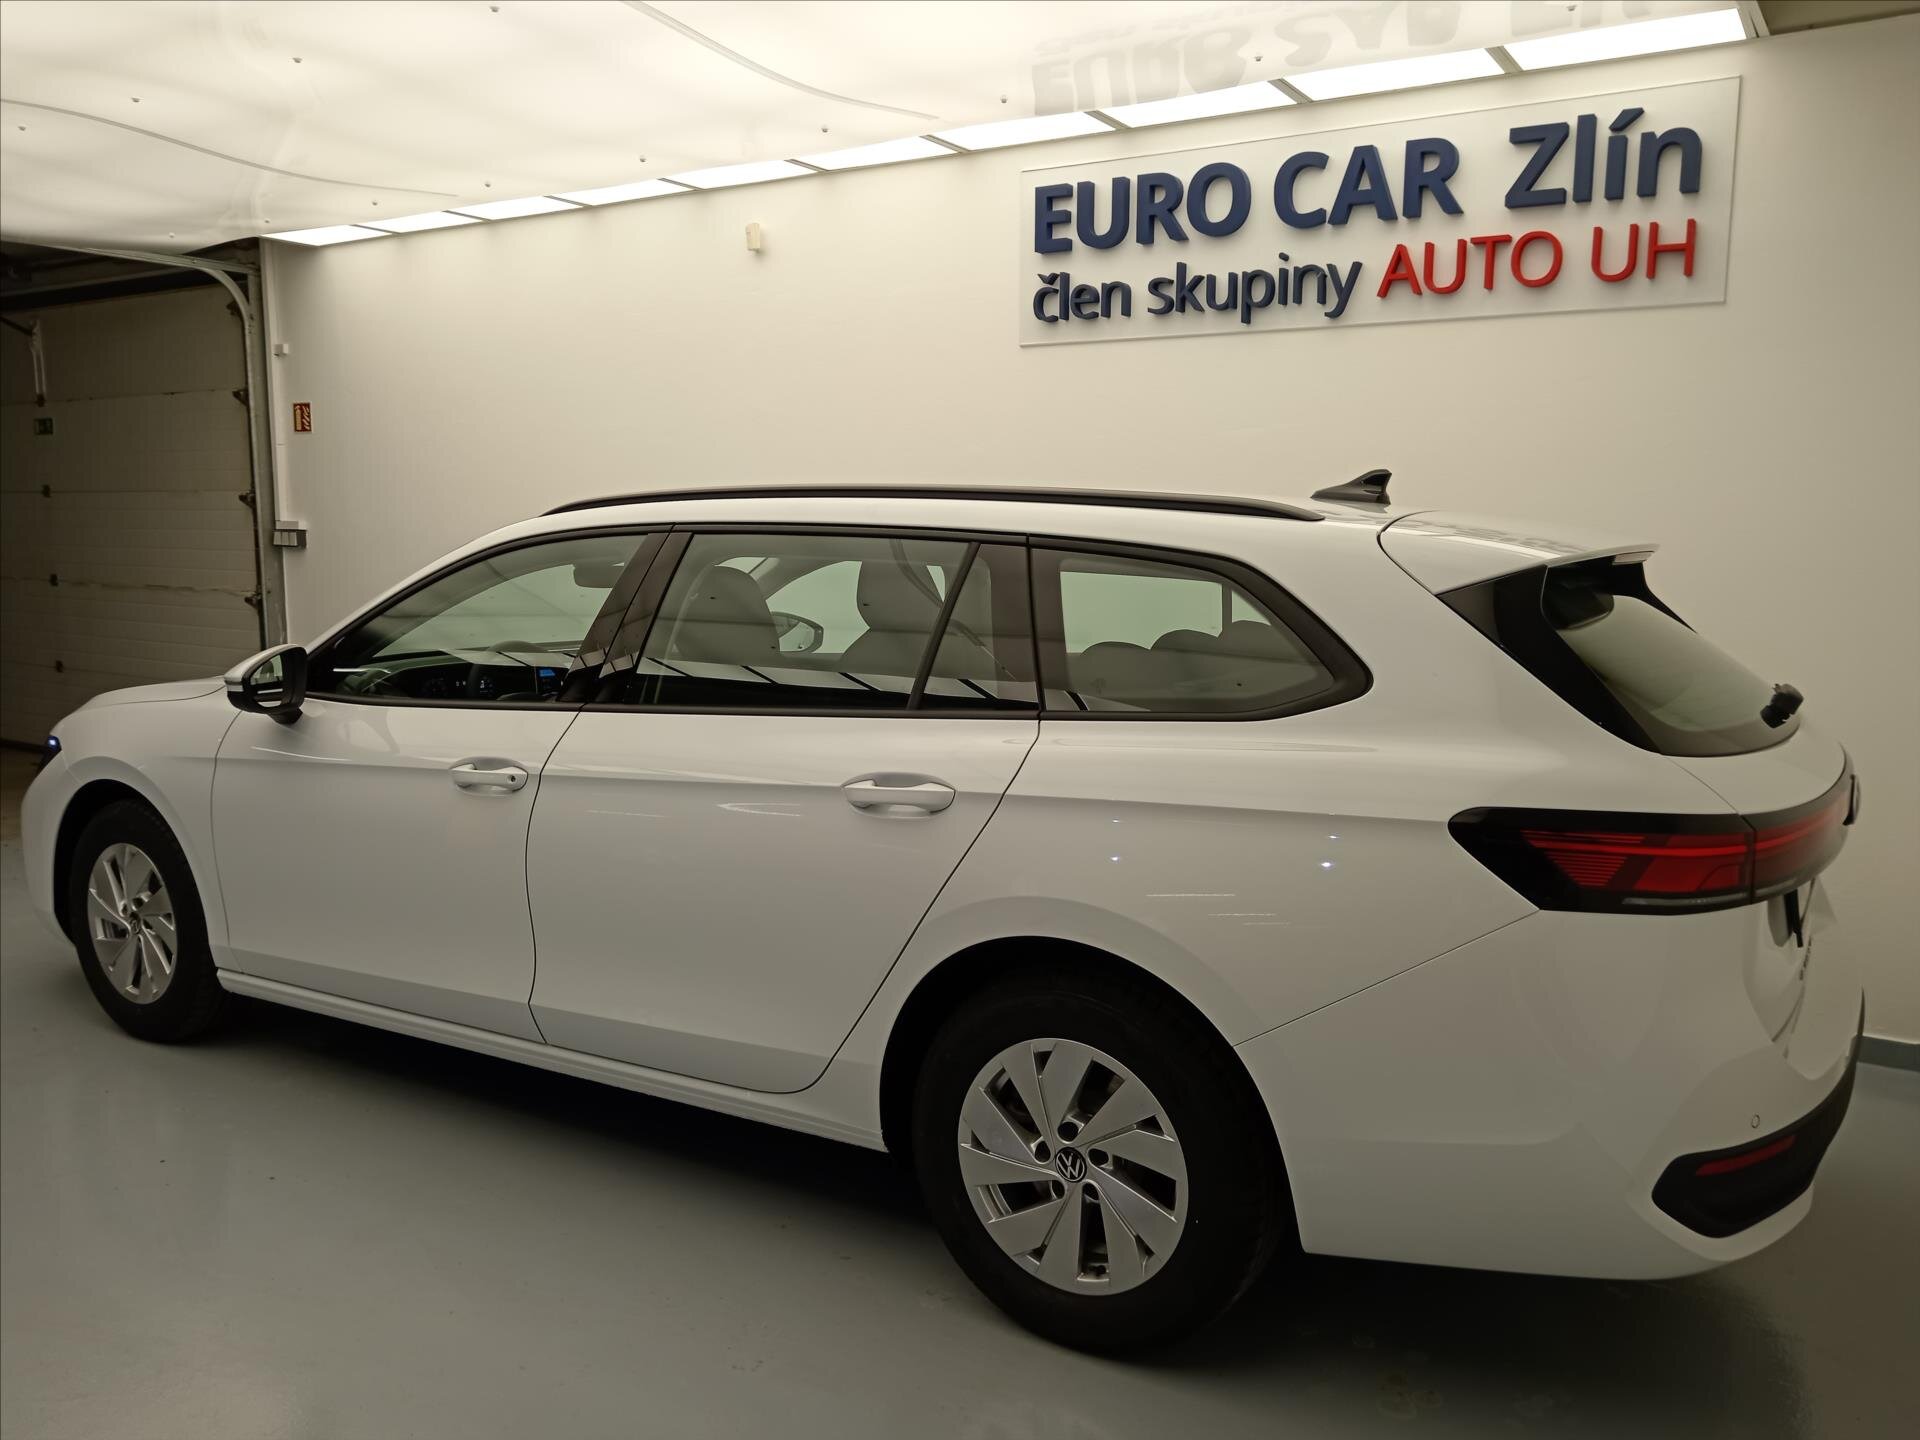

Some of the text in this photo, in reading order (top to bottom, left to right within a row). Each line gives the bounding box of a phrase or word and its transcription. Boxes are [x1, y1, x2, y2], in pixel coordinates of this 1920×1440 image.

[1033, 107, 1703, 255] EURO CAR Zlín
[1032, 218, 1699, 325] člen skupiny AUTO UH
[1056, 1151, 1085, 1181] VW
